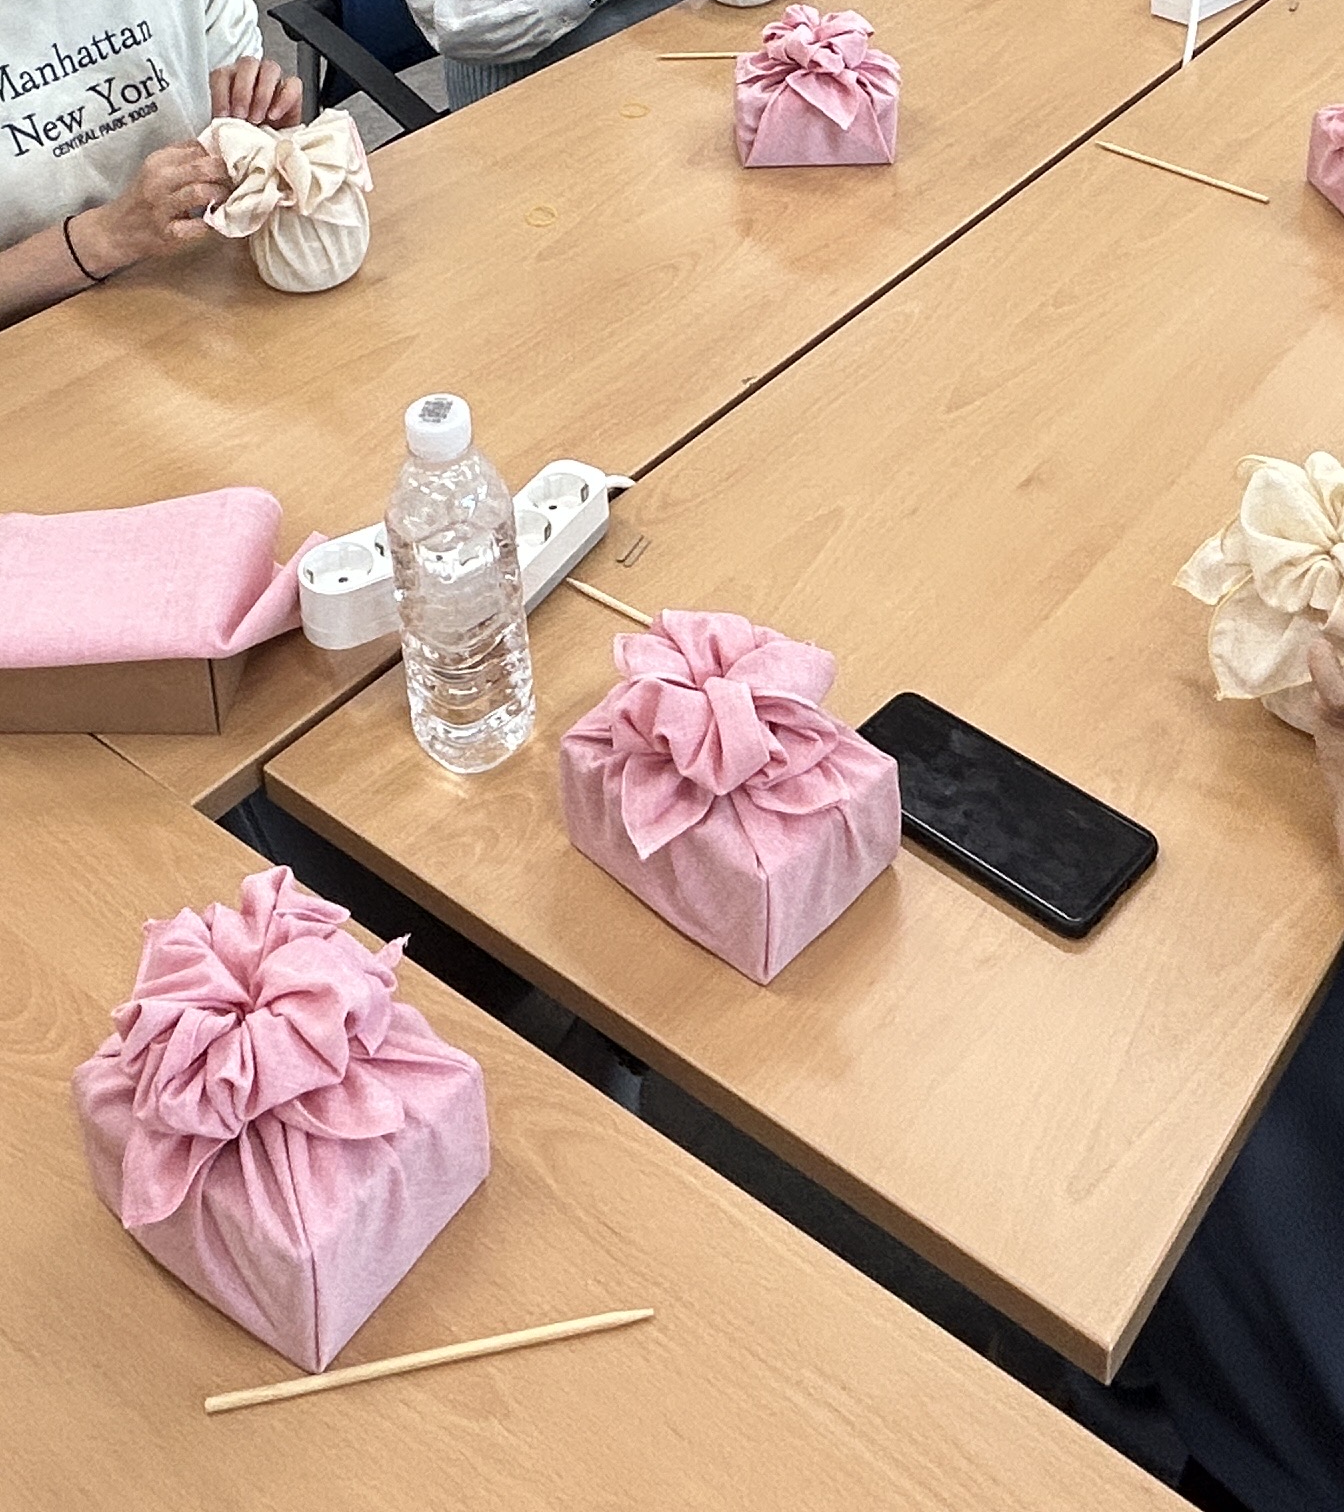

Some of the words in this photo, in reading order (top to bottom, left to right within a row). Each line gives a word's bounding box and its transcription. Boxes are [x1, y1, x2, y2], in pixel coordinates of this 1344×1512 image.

[1, 105, 85, 158] New
[86, 57, 170, 116] York
[52, 128, 99, 158] CENTRAL
[98, 114, 128, 137] PARK
